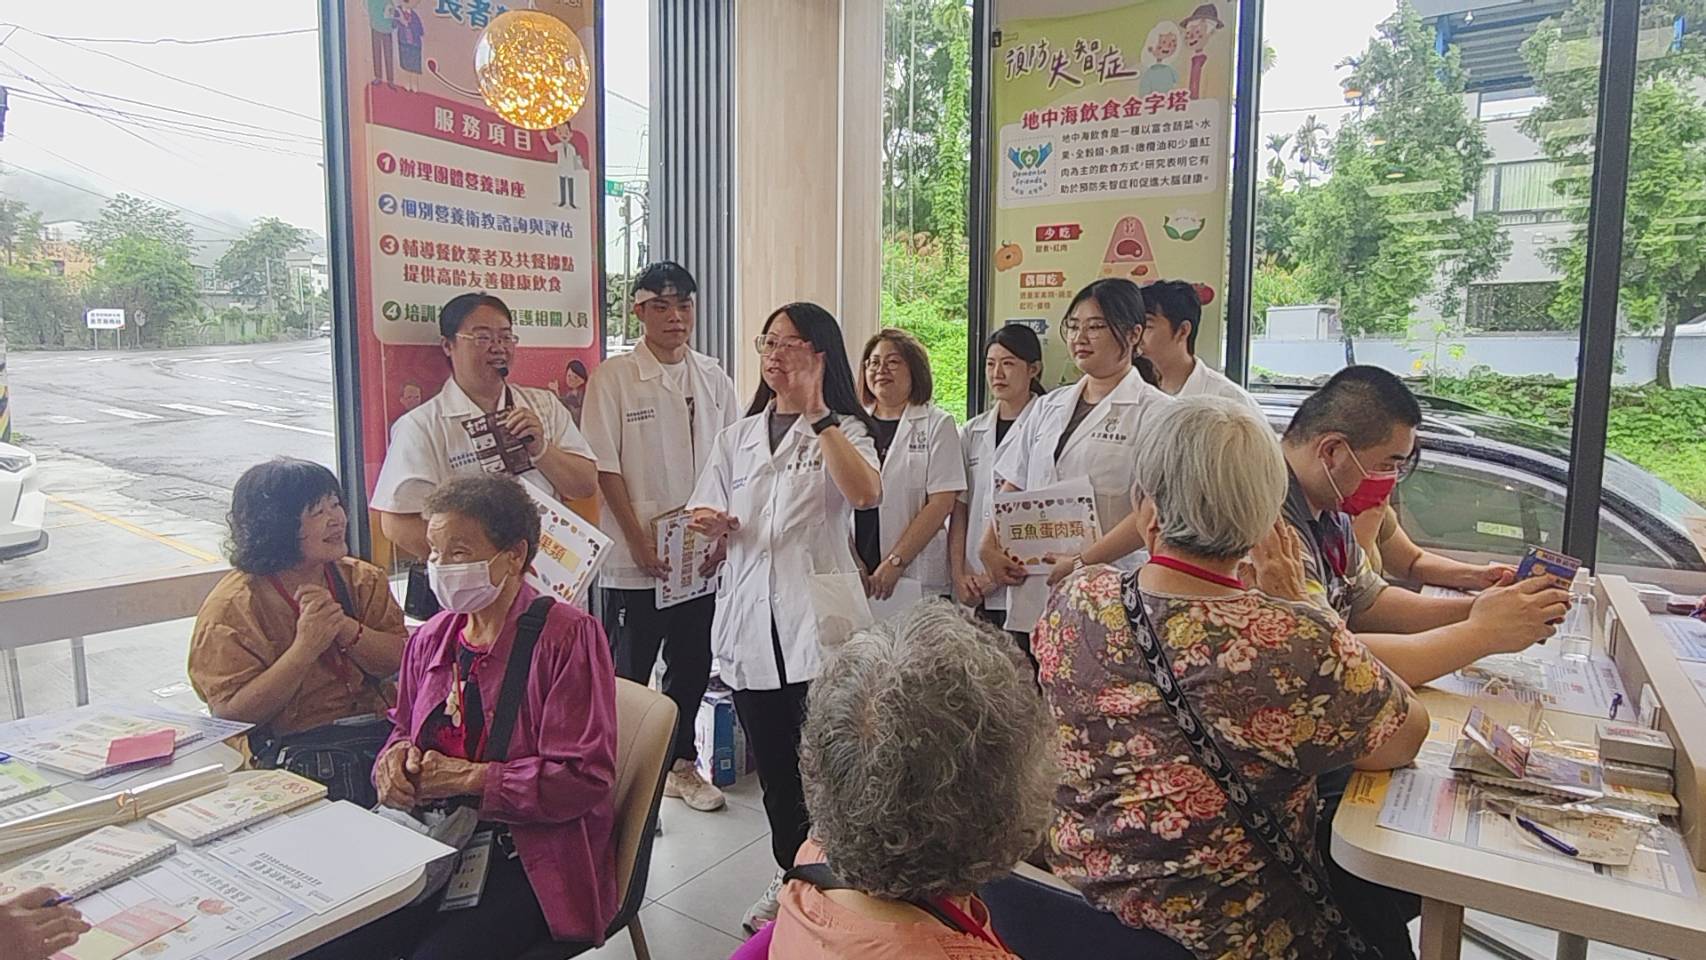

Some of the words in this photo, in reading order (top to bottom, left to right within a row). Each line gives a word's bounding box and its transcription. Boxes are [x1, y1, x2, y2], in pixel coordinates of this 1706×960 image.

[1005, 39, 1138, 88] 預防失智症
[434, 107, 531, 150] 服務項目
[1021, 91, 1190, 130] 地中海飲食金字塔
[400, 158, 527, 198] 辦理團體營養講座
[401, 199, 573, 238] 個別營養衛教諮詢與評估
[1044, 227, 1071, 240] 少吃
[402, 238, 575, 272] 輔導餐飲業者及共餐據點
[403, 264, 562, 293] 提供高齡友善健康飲食
[1009, 521, 1085, 541] 豆魚蛋肉類
